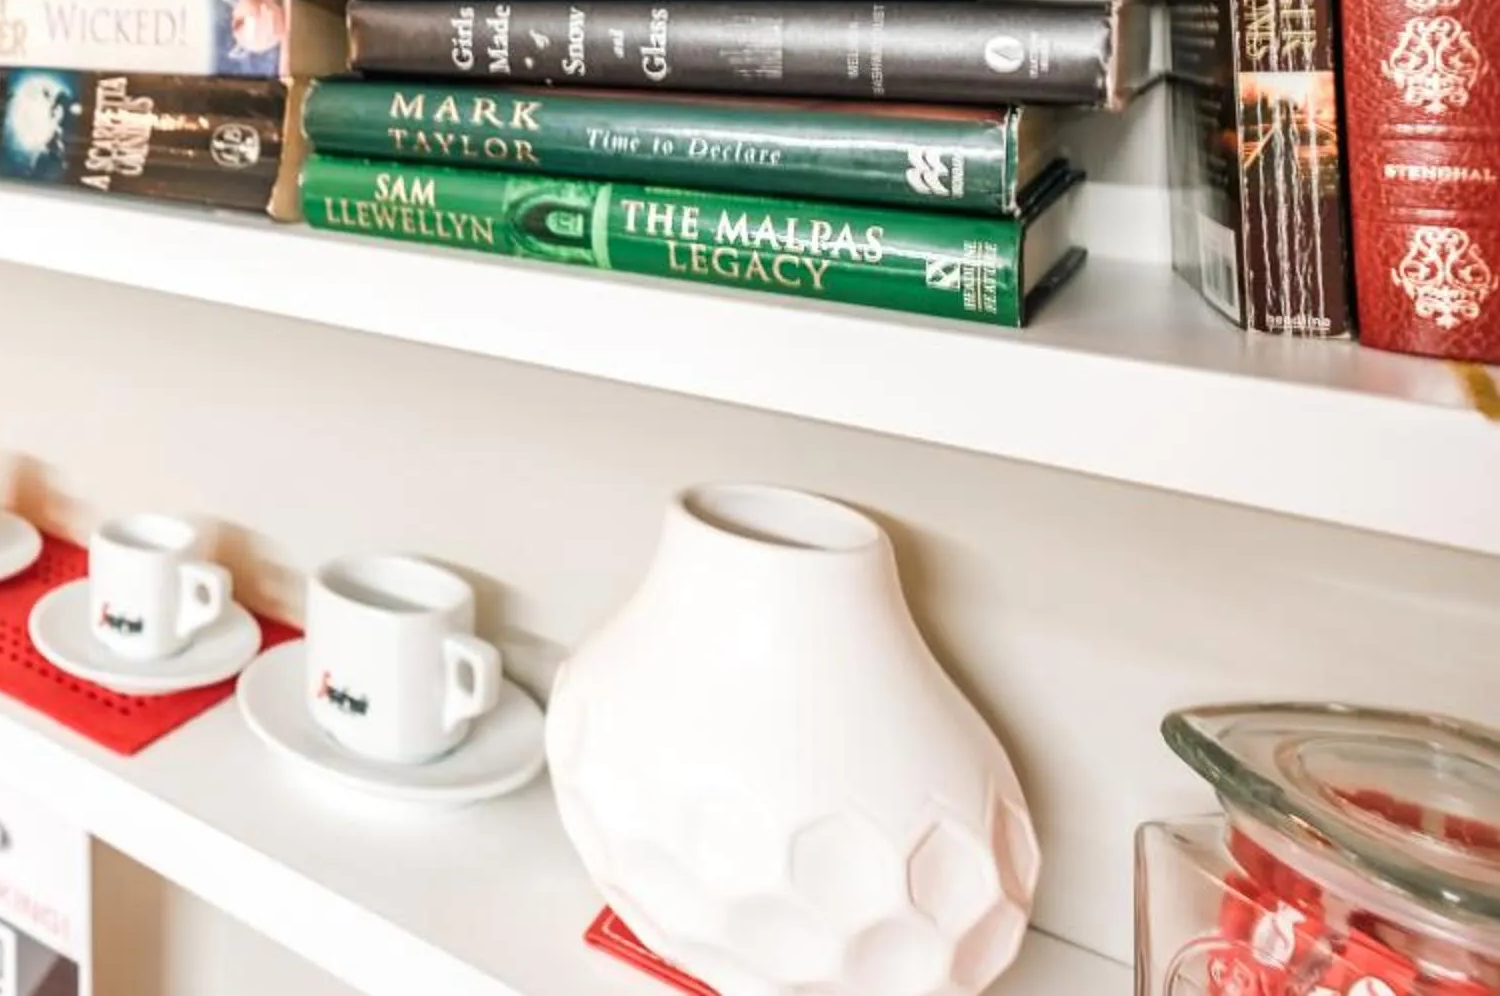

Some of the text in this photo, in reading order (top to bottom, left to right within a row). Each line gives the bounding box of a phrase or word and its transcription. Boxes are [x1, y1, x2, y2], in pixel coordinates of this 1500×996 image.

[450, 5, 476, 71] Girls
[486, 3, 511, 75] Made
[561, 6, 586, 77] Snow
[639, 7, 669, 82] Glass
[389, 91, 543, 132] MARK
[387, 127, 540, 165] TAYLOR
[586, 125, 783, 166] Time to Declare
[373, 171, 437, 209] SAM
[324, 196, 495, 247] LLEWELLYN
[620, 198, 886, 264] THE MALPAS
[665, 239, 832, 291] LEGACY
